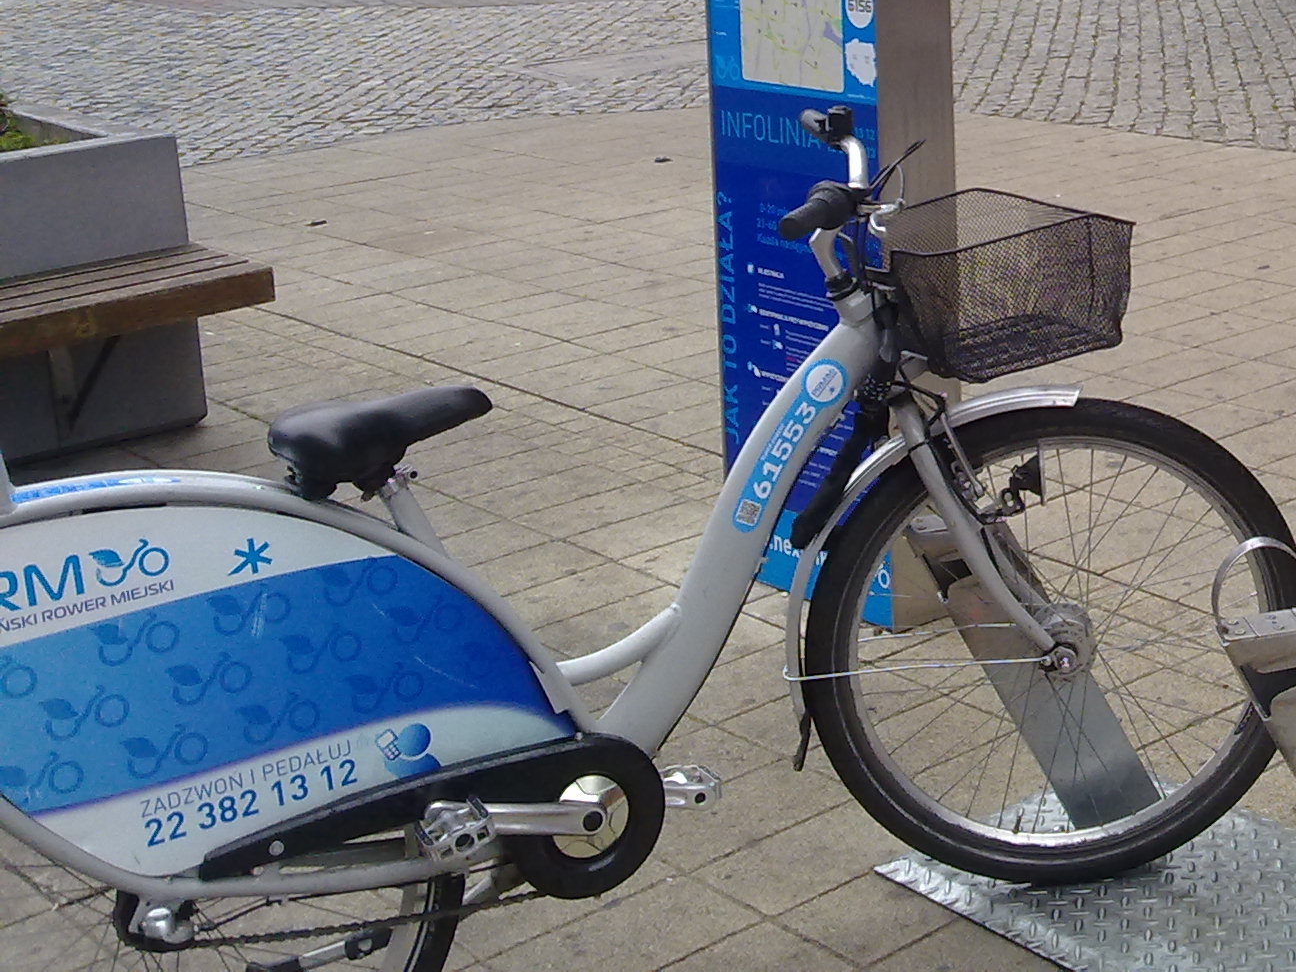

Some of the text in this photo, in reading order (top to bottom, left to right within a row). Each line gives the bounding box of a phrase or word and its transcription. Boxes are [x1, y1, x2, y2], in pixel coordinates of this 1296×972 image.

[716, 190, 740, 445] JAK TO DZIAŁA?
[753, 401, 816, 499] 61553
[42, 596, 107, 623] ROWER
[111, 579, 175, 606] MIEJSKI
[144, 758, 359, 848] 22 382 13 12
[262, 739, 352, 781] PEDAŁUJ
